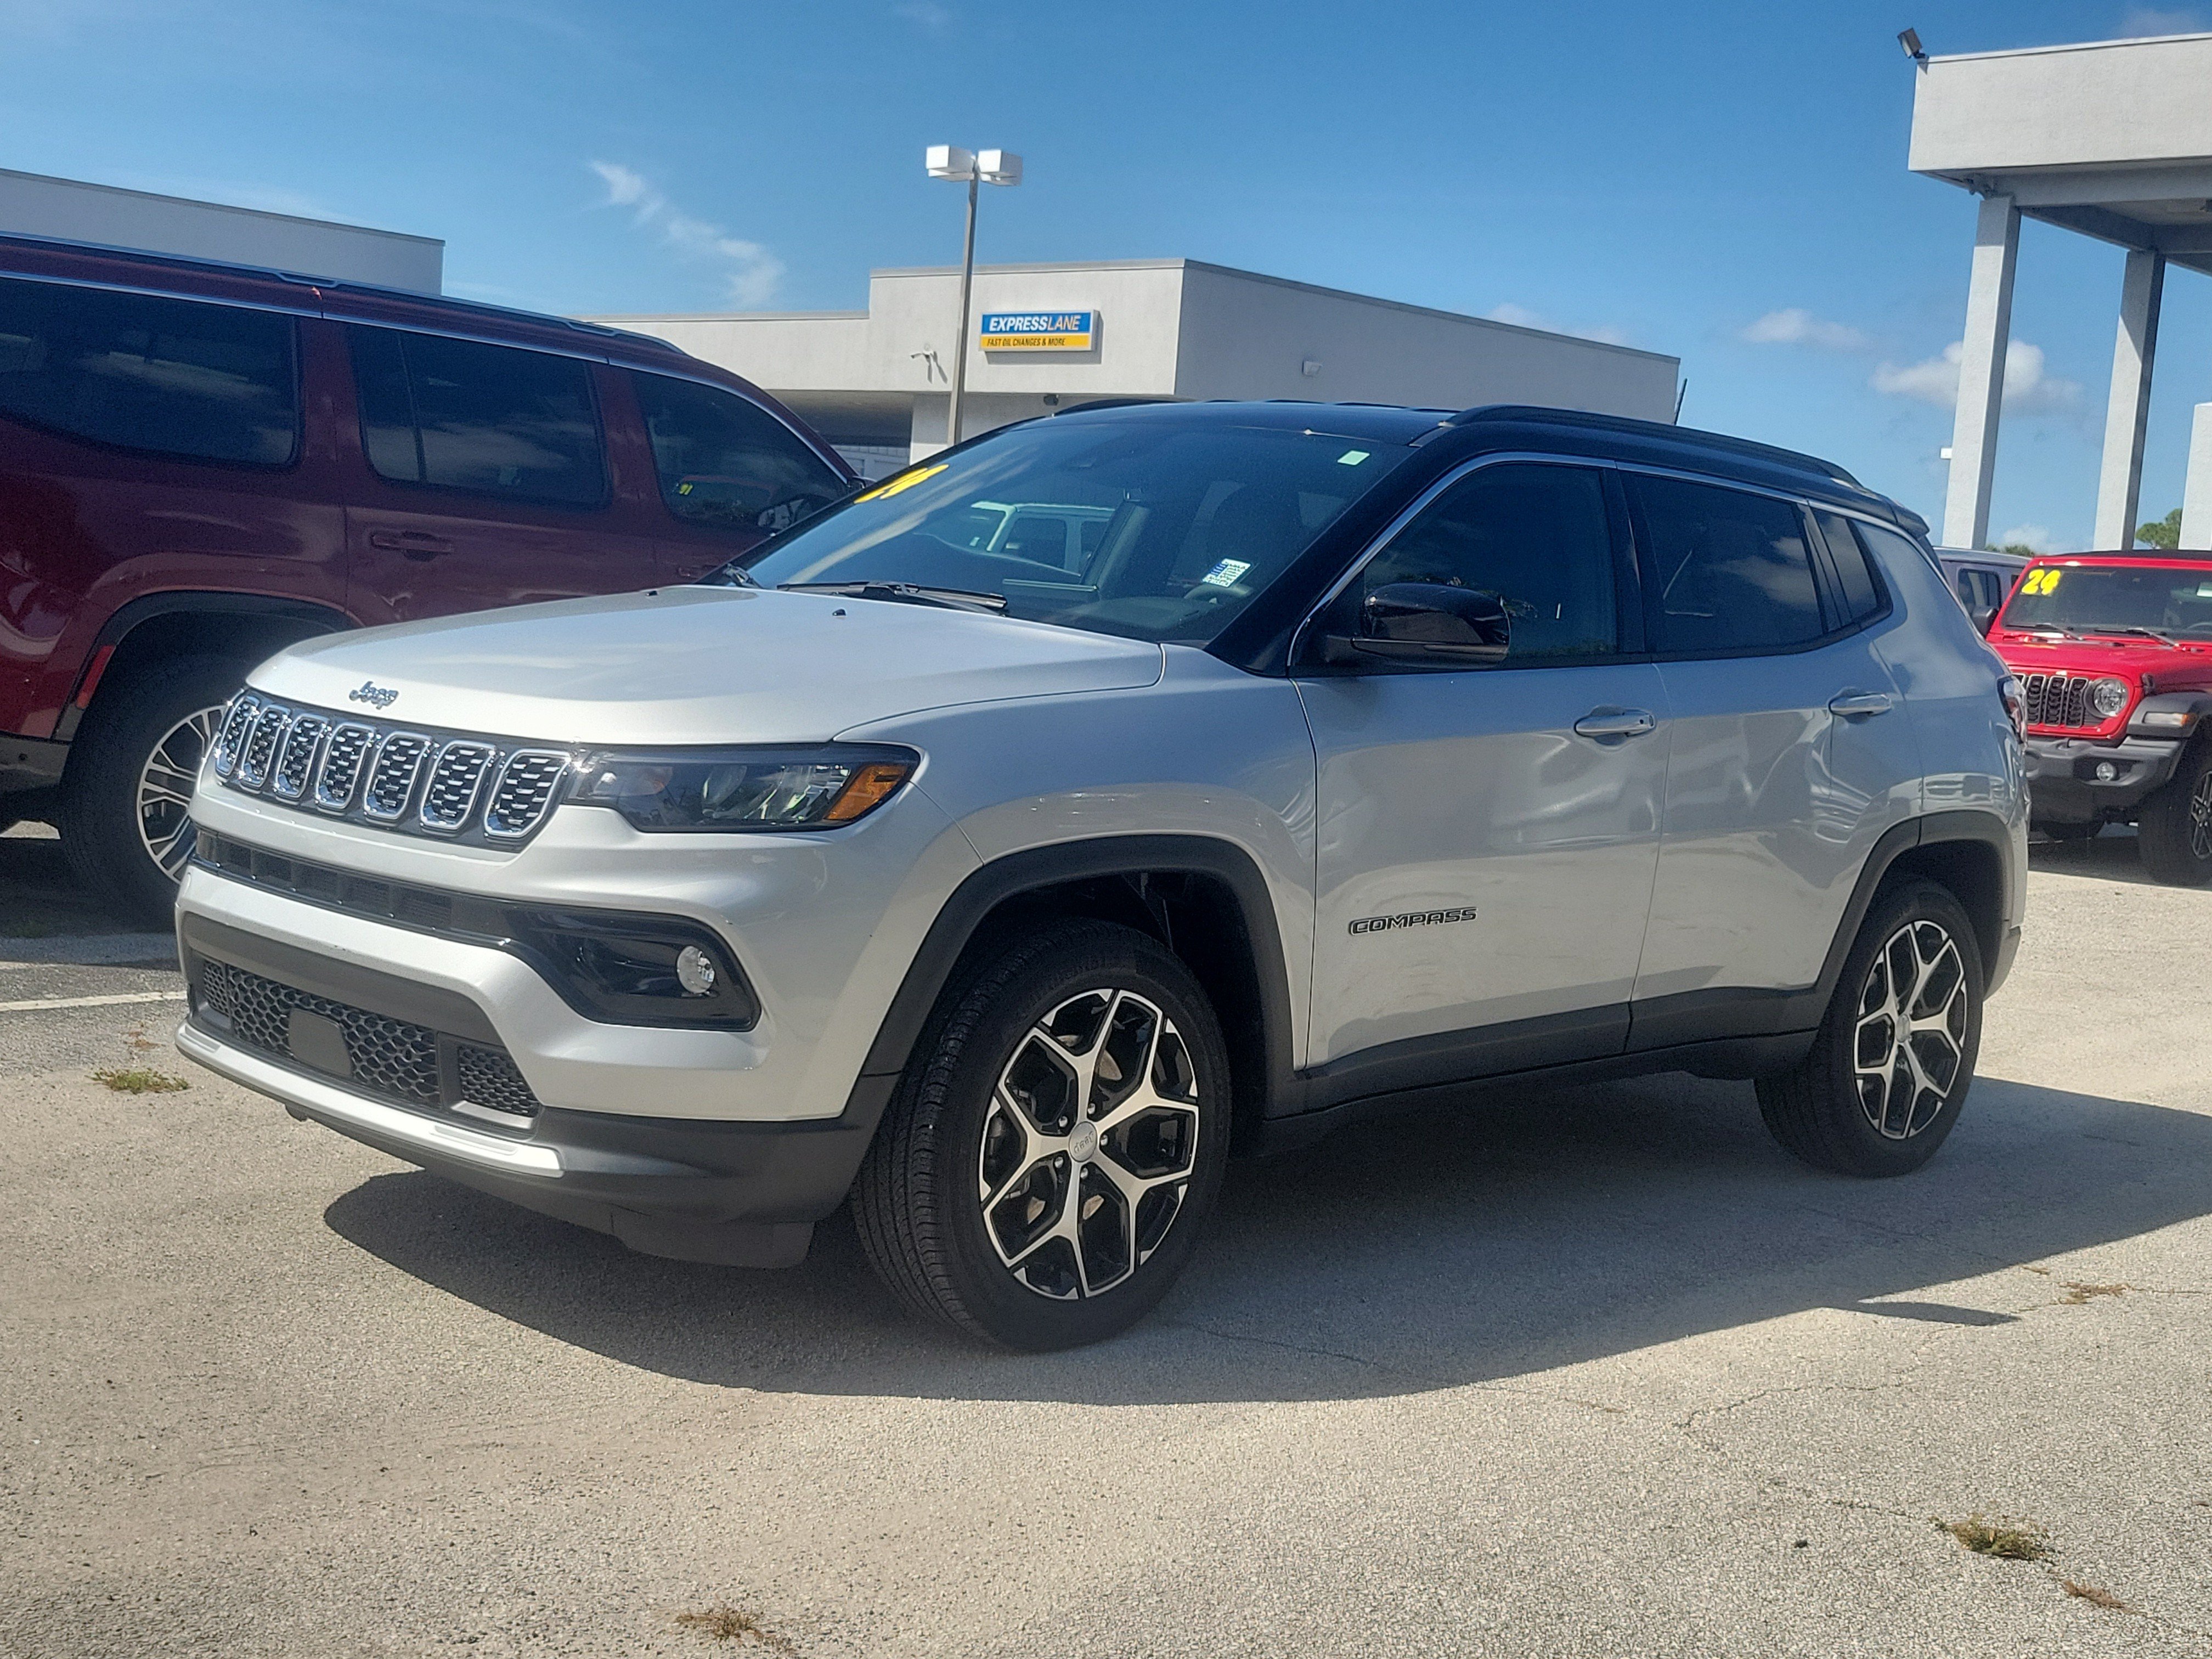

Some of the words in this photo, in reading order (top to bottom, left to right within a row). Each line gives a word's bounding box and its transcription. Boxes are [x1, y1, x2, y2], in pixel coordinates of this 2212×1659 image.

[989, 315, 1081, 332] EXPRESSLANE
[987, 338, 1001, 347] FAST
[1013, 337, 1041, 346] CHANGES
[1042, 337, 1047, 346] &
[1048, 337, 1066, 346] MORE
[2021, 569, 2061, 595] 24
[349, 681, 399, 710] Jeep
[1349, 907, 1478, 935] COMPASS
